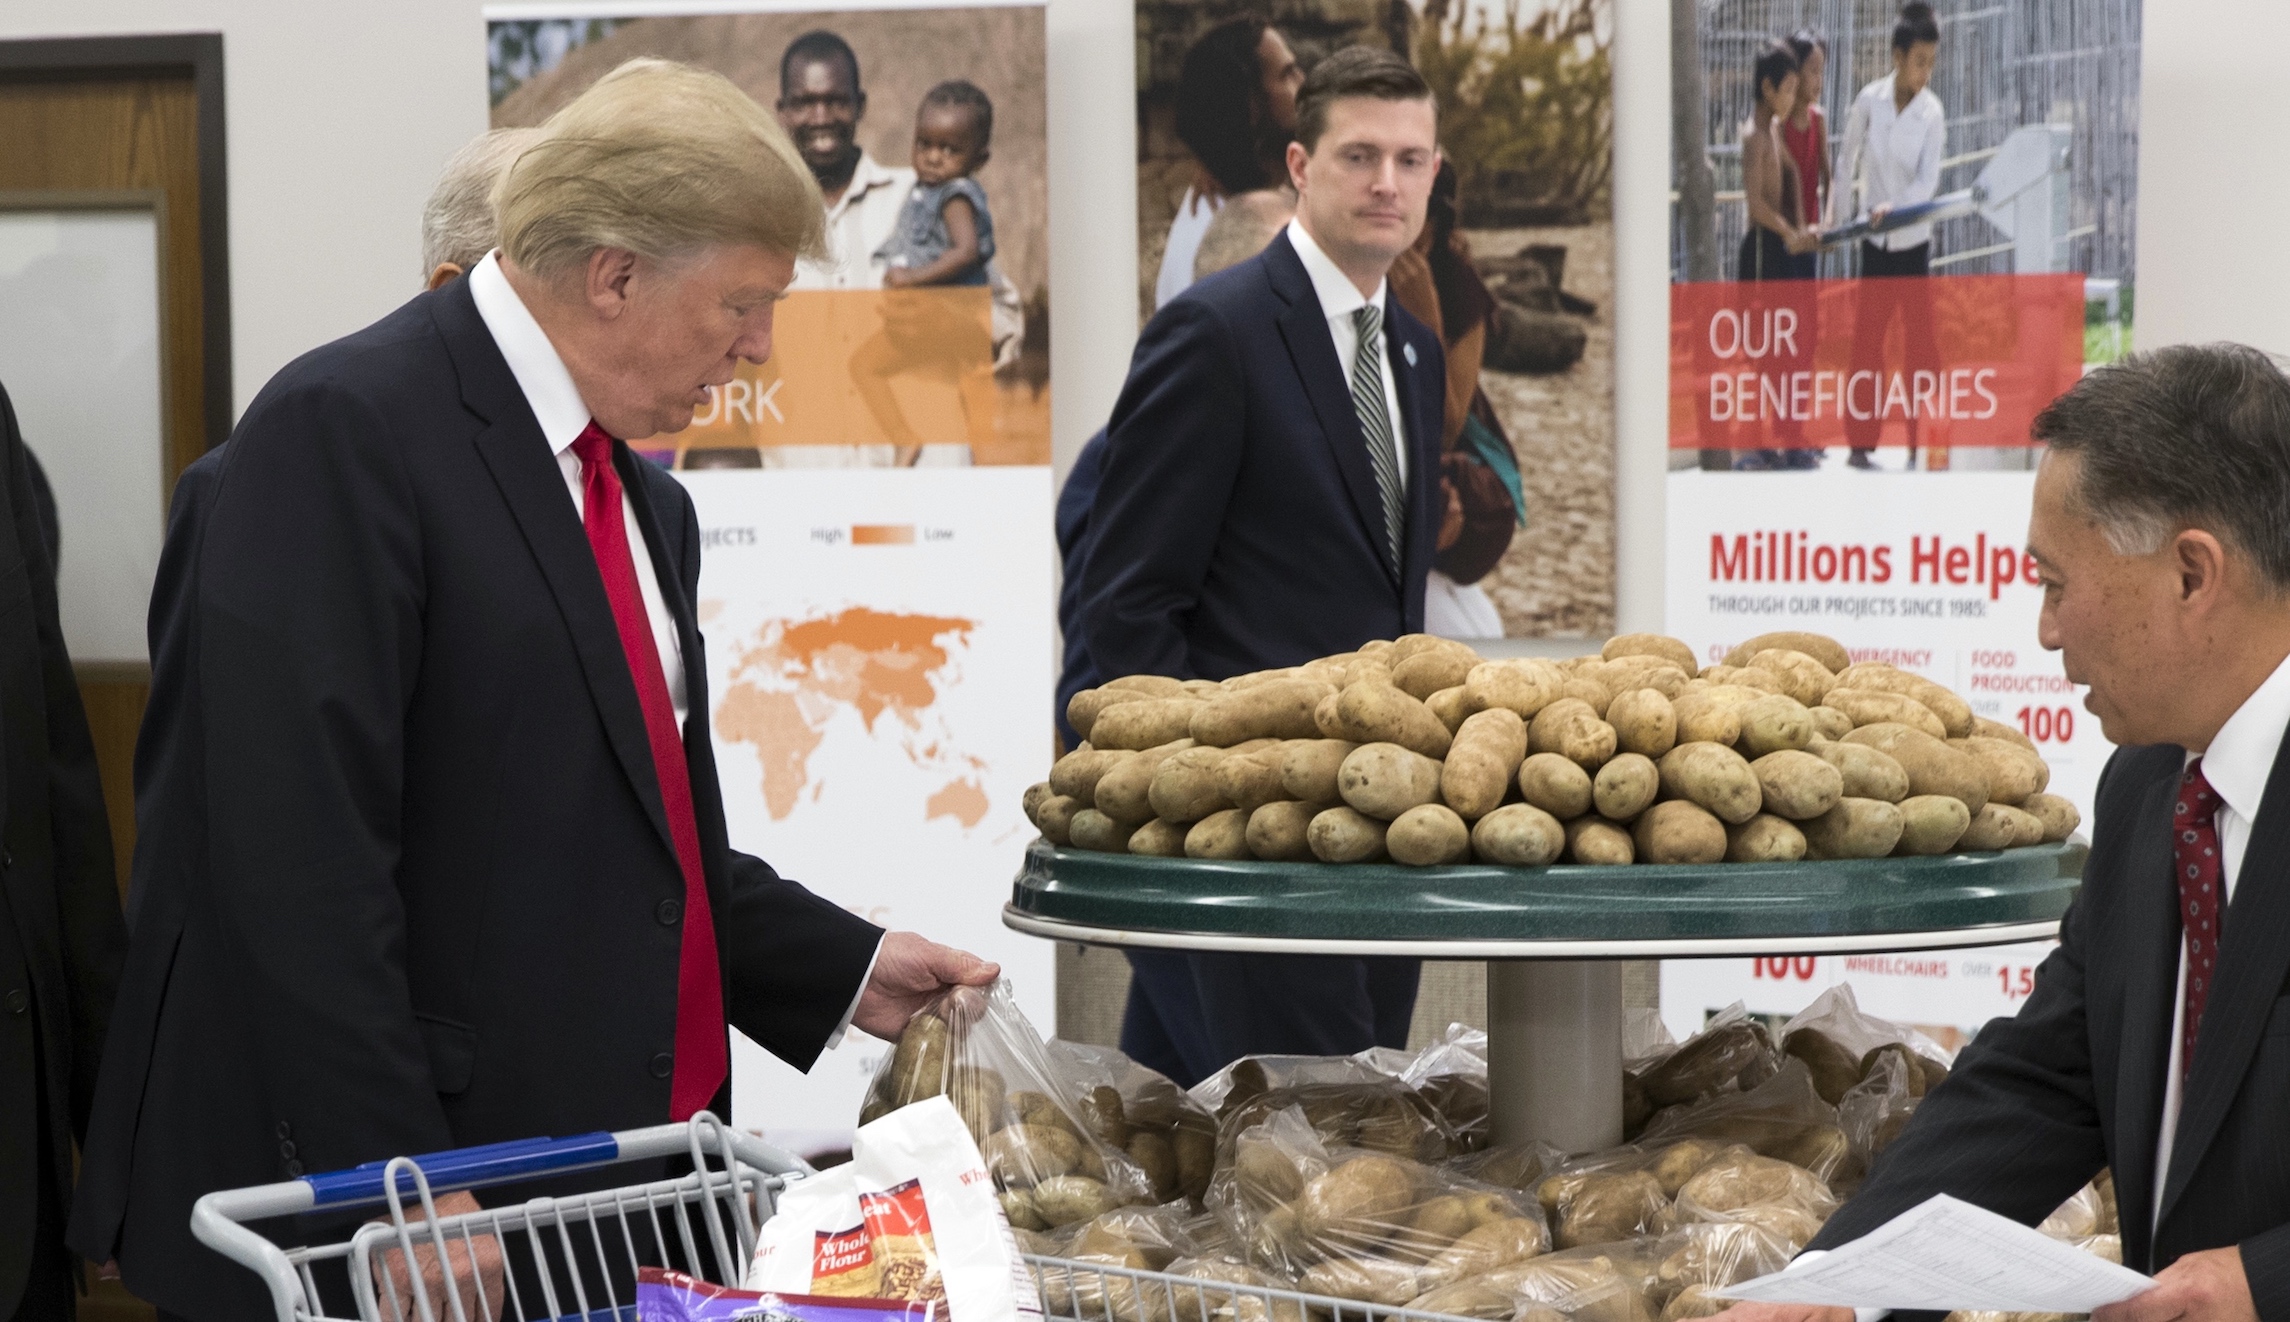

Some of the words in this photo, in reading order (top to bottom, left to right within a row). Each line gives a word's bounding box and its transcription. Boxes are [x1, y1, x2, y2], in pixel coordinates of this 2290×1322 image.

[1709, 308, 1799, 359] OUR
[690, 378, 784, 427] ORK
[1709, 369, 1999, 422] BENEFICIARIES
[810, 525, 843, 544] High
[924, 527, 955, 541] Low
[1710, 530, 1893, 583] Millions
[1910, 532, 2040, 602] Helpe
[1707, 593, 1784, 616] THROUGH
[1788, 595, 1819, 616] OUR
[1824, 597, 1896, 621] PROJECTS
[1900, 599, 1944, 618] SINCE
[1847, 648, 1932, 667] MERGENCY
[1971, 650, 2016, 669] FOOD
[1971, 674, 2075, 694] PRODUCTION
[2017, 705, 2074, 744] 100
[1844, 956, 1949, 979] WHEELCHAIRS
[863, 1202, 892, 1218] eat
[820, 1250, 866, 1272] Flour
